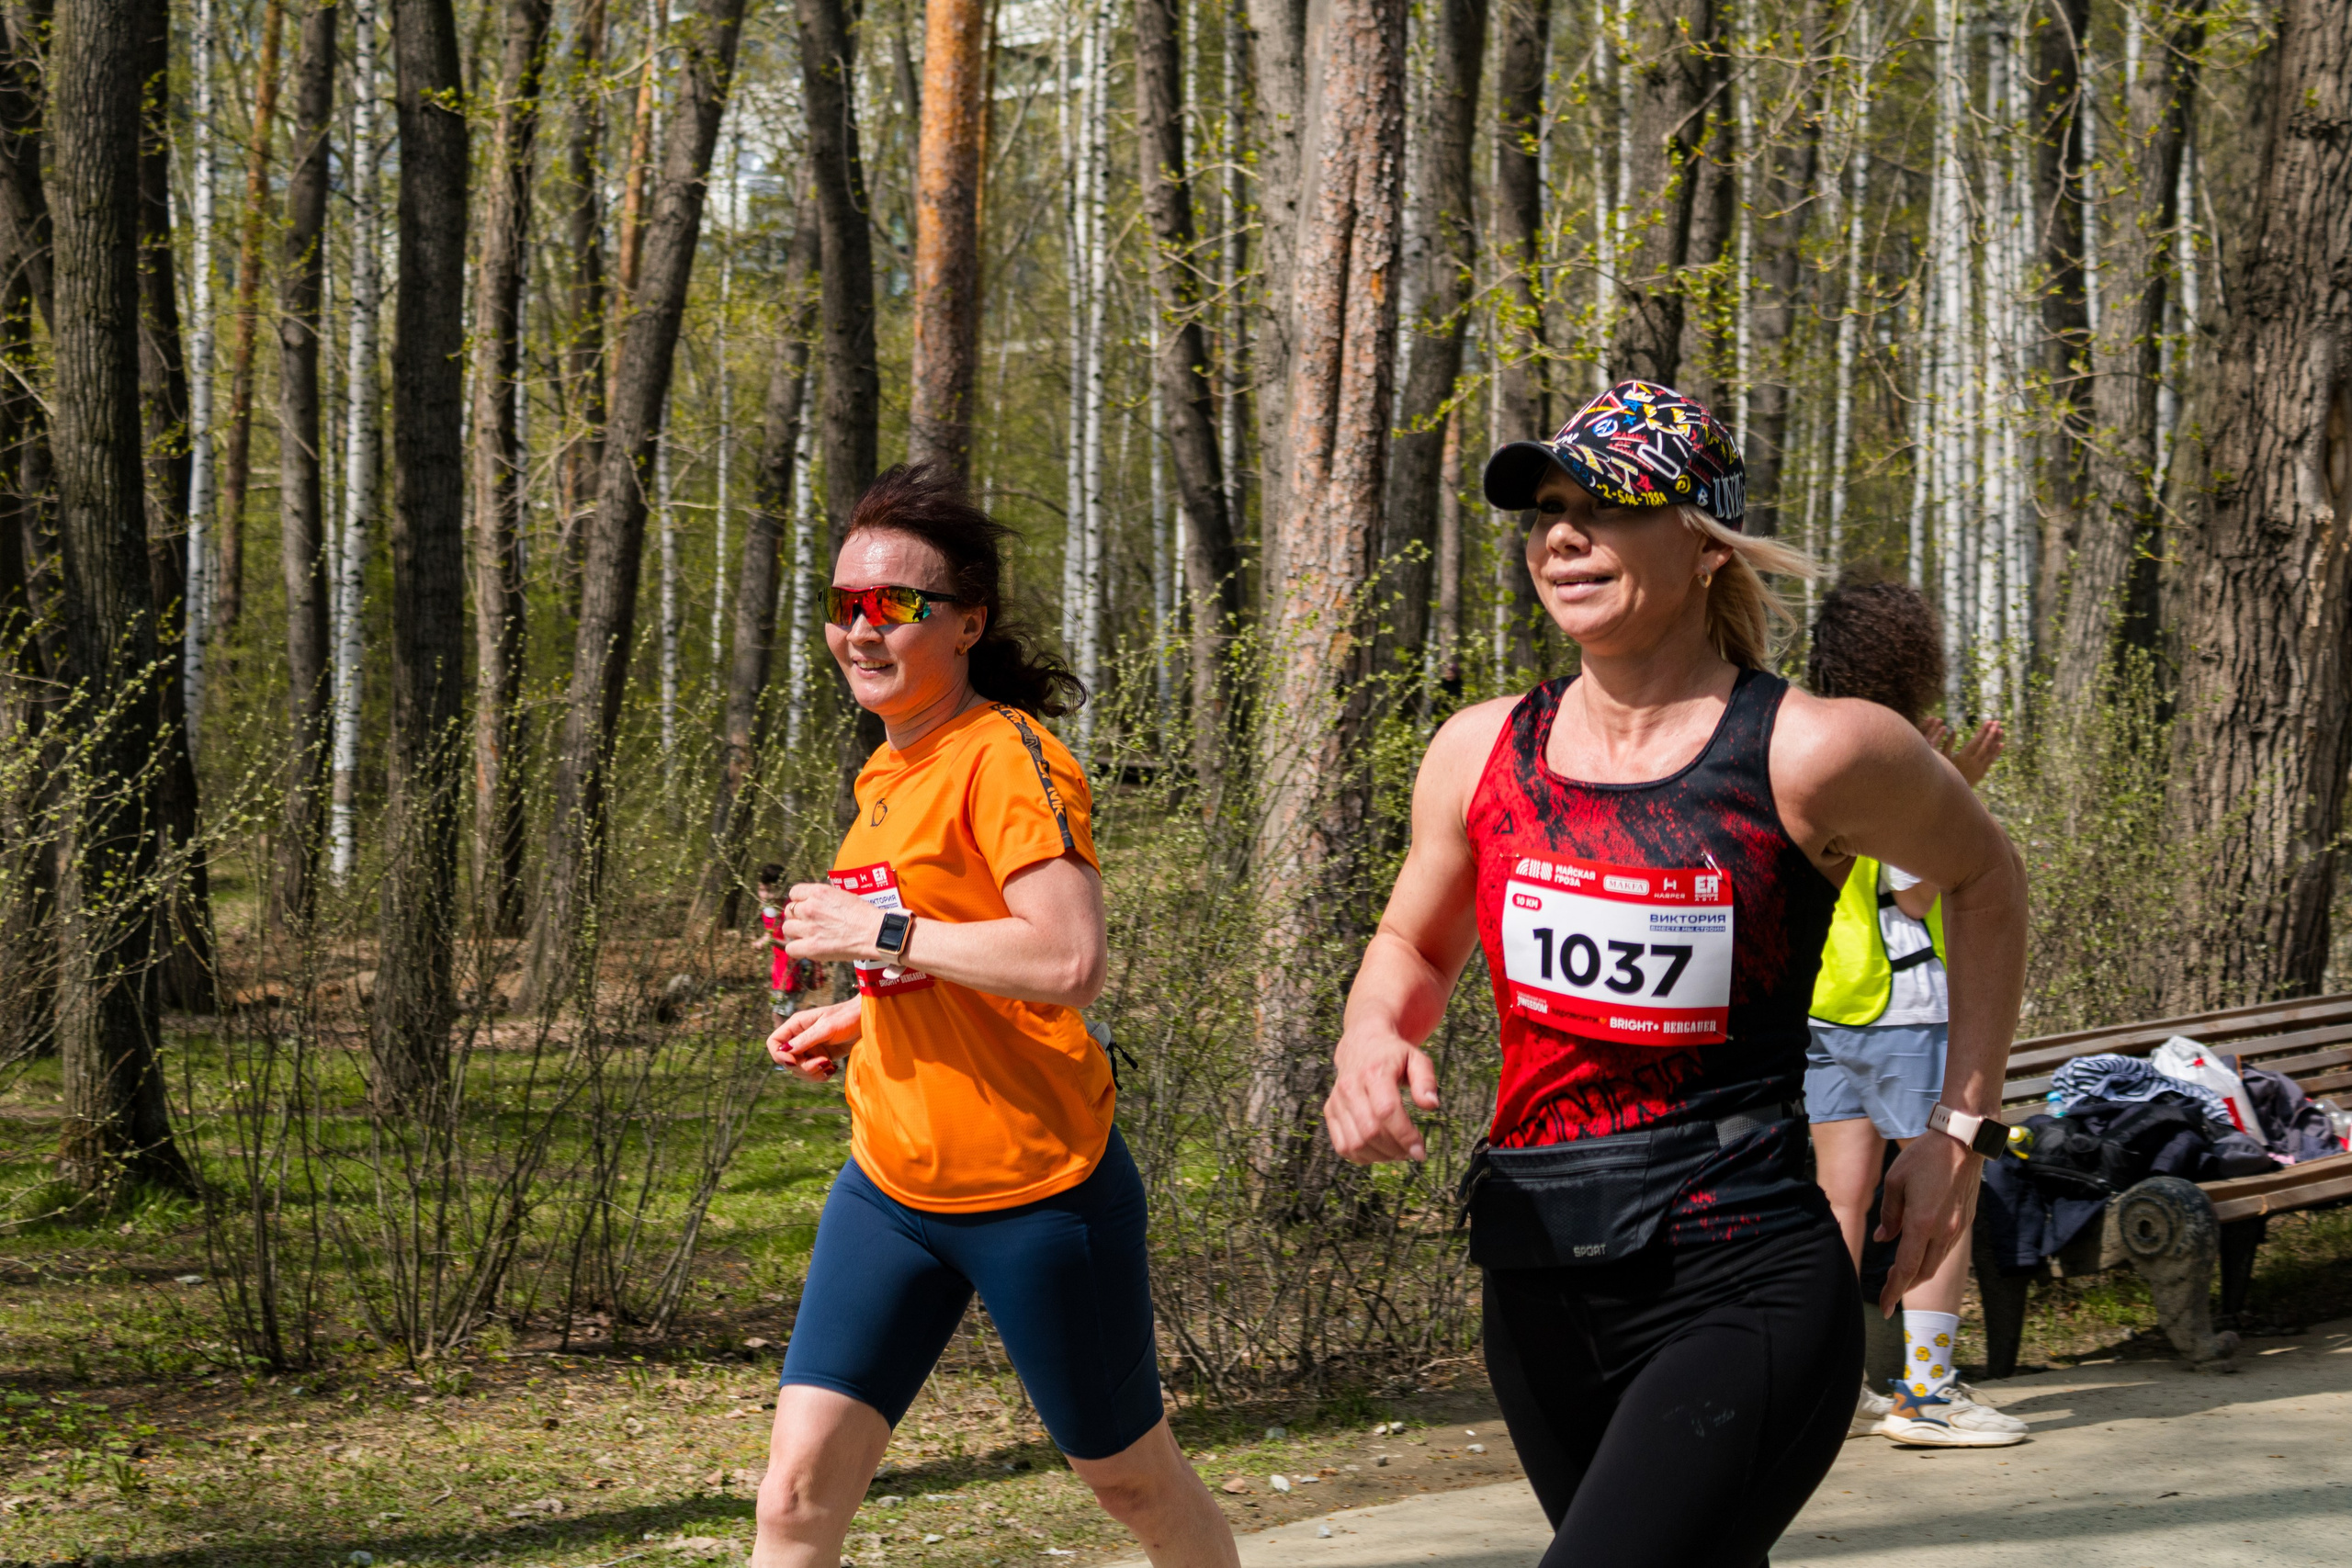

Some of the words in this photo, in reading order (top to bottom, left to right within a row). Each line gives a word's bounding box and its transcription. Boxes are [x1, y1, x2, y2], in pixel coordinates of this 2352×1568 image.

[1555, 864, 1596, 881] МАЙСКАЯ
[1555, 874, 1580, 887] ГРОЗА
[1608, 879, 1645, 892] MAKFA
[1516, 895, 1525, 906] 10
[1650, 913, 1726, 924] ВИКТОРИЯ
[1532, 927, 1693, 998] 1037
[1610, 1016, 1653, 1032] BRIGHT
[1663, 1020, 1716, 1033] BERGAUER
[1574, 1243, 1606, 1258] SPORT
